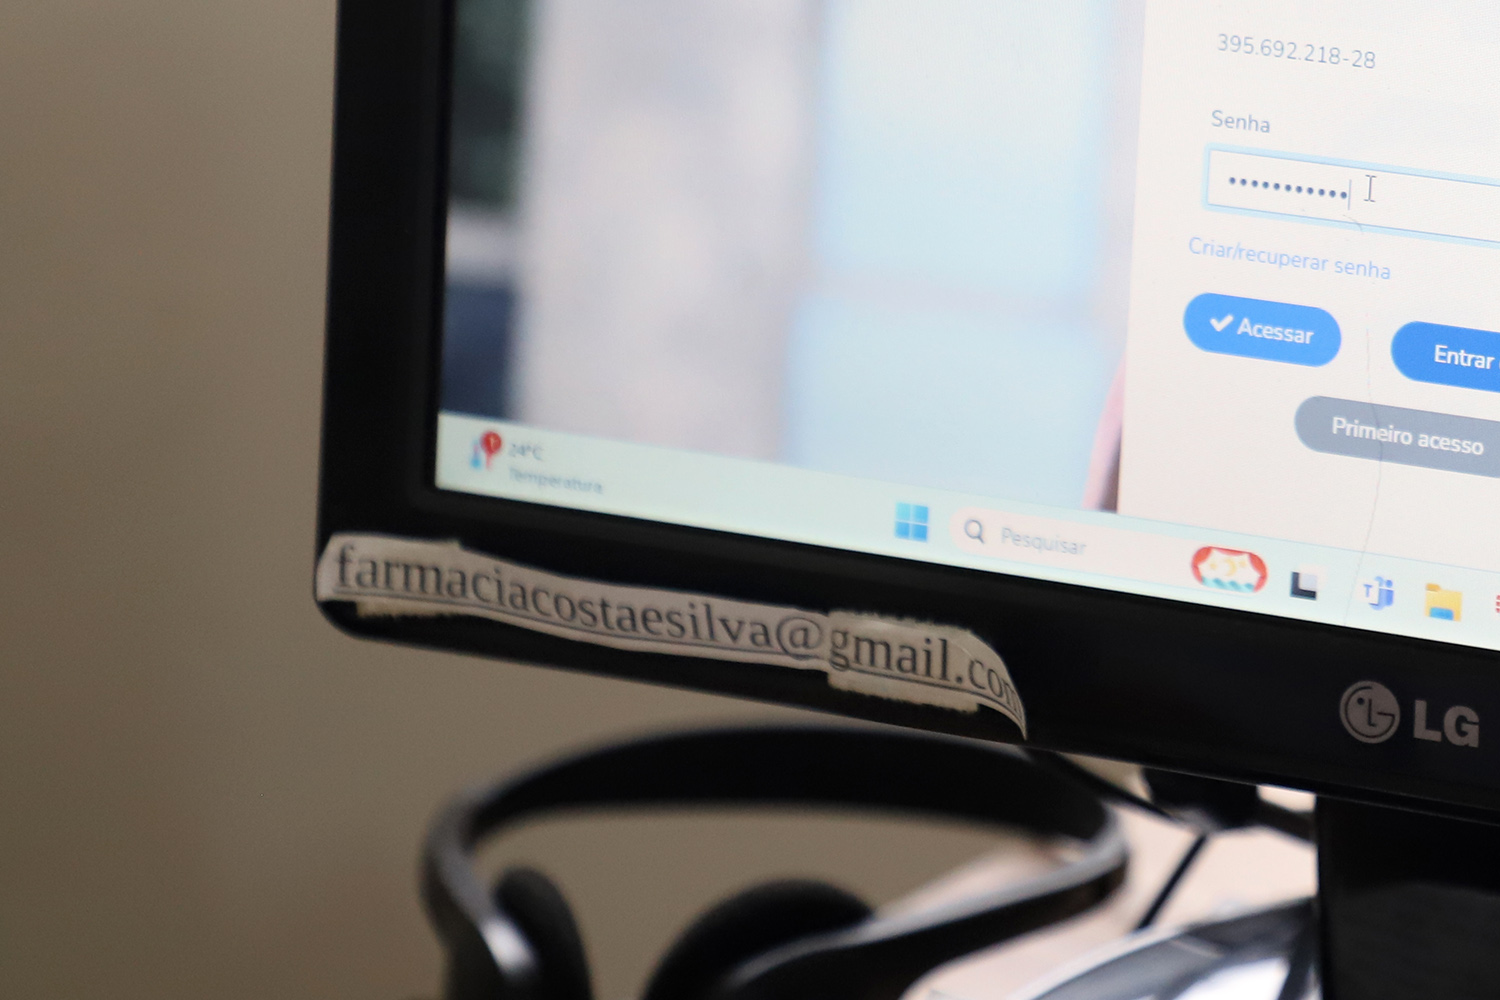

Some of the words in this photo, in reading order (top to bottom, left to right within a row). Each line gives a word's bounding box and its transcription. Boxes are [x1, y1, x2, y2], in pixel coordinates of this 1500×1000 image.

[1217, 32, 1378, 69] 395.692.218-28
[1210, 109, 1272, 134] Senha
[1188, 235, 1329, 271] Criar/recuperar
[1334, 260, 1392, 281] senha
[1237, 317, 1315, 346] Acessar
[1434, 343, 1494, 372] Entrar
[1332, 415, 1413, 446] Primeiro
[1417, 434, 1485, 456] acesso
[1000, 526, 1088, 554] Pesquisar
[1413, 698, 1481, 748] LG
